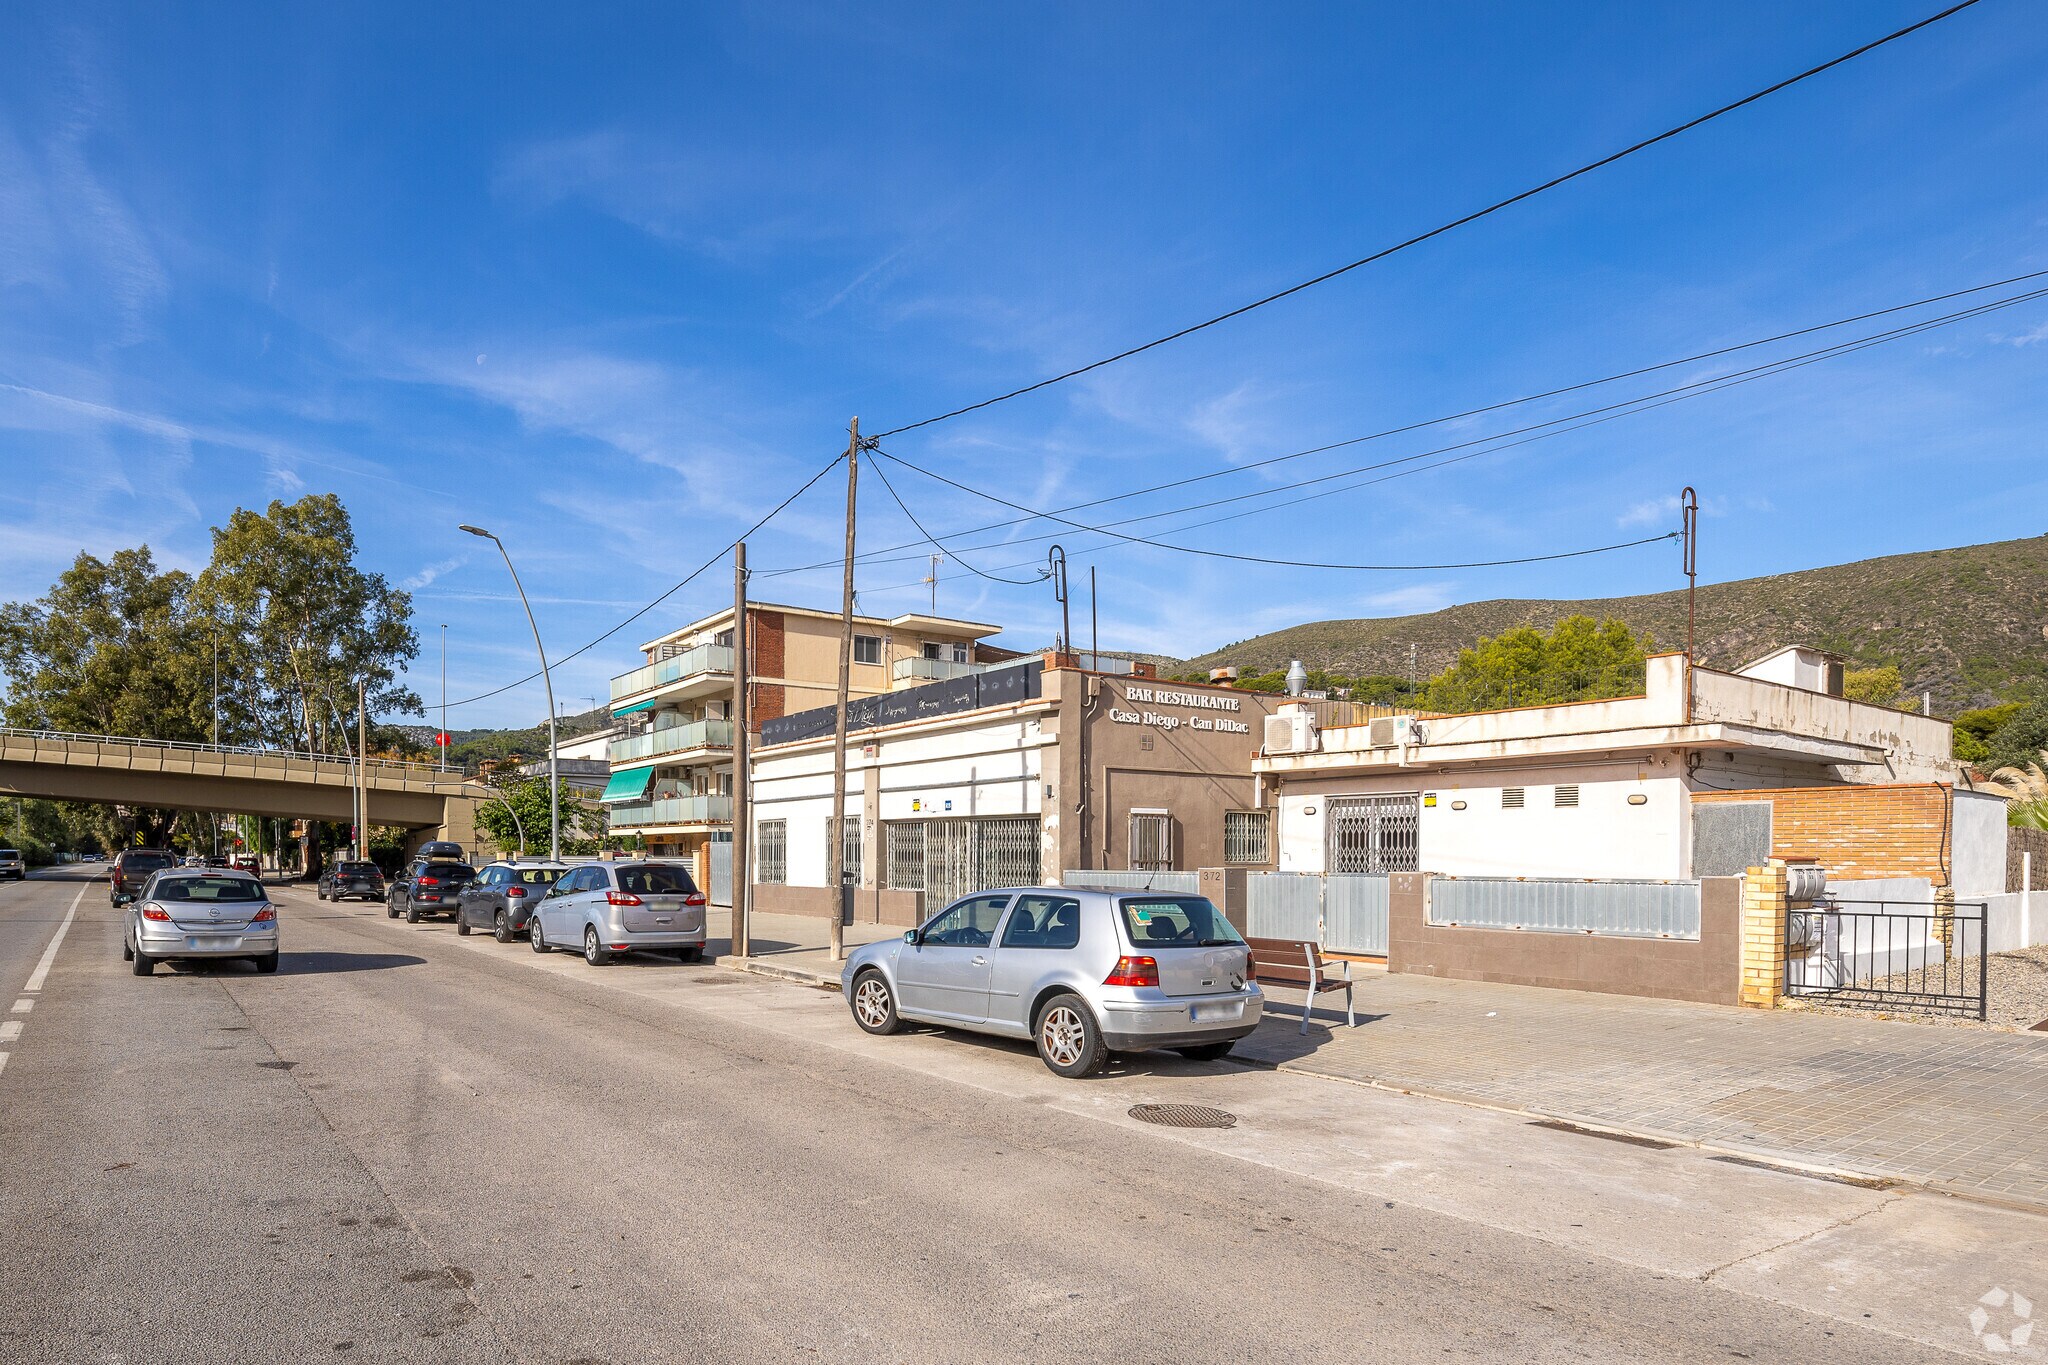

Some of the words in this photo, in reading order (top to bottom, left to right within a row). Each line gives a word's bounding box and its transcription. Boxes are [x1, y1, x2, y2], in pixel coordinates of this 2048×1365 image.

[1126, 687, 1153, 701] BAR
[1155, 690, 1240, 710] RESTAURANTE
[1109, 708, 1140, 724] Casa
[1143, 711, 1180, 730] Diego
[1189, 716, 1213, 730] Can
[1215, 719, 1250, 733] DiDac
[1203, 871, 1221, 881] 372
